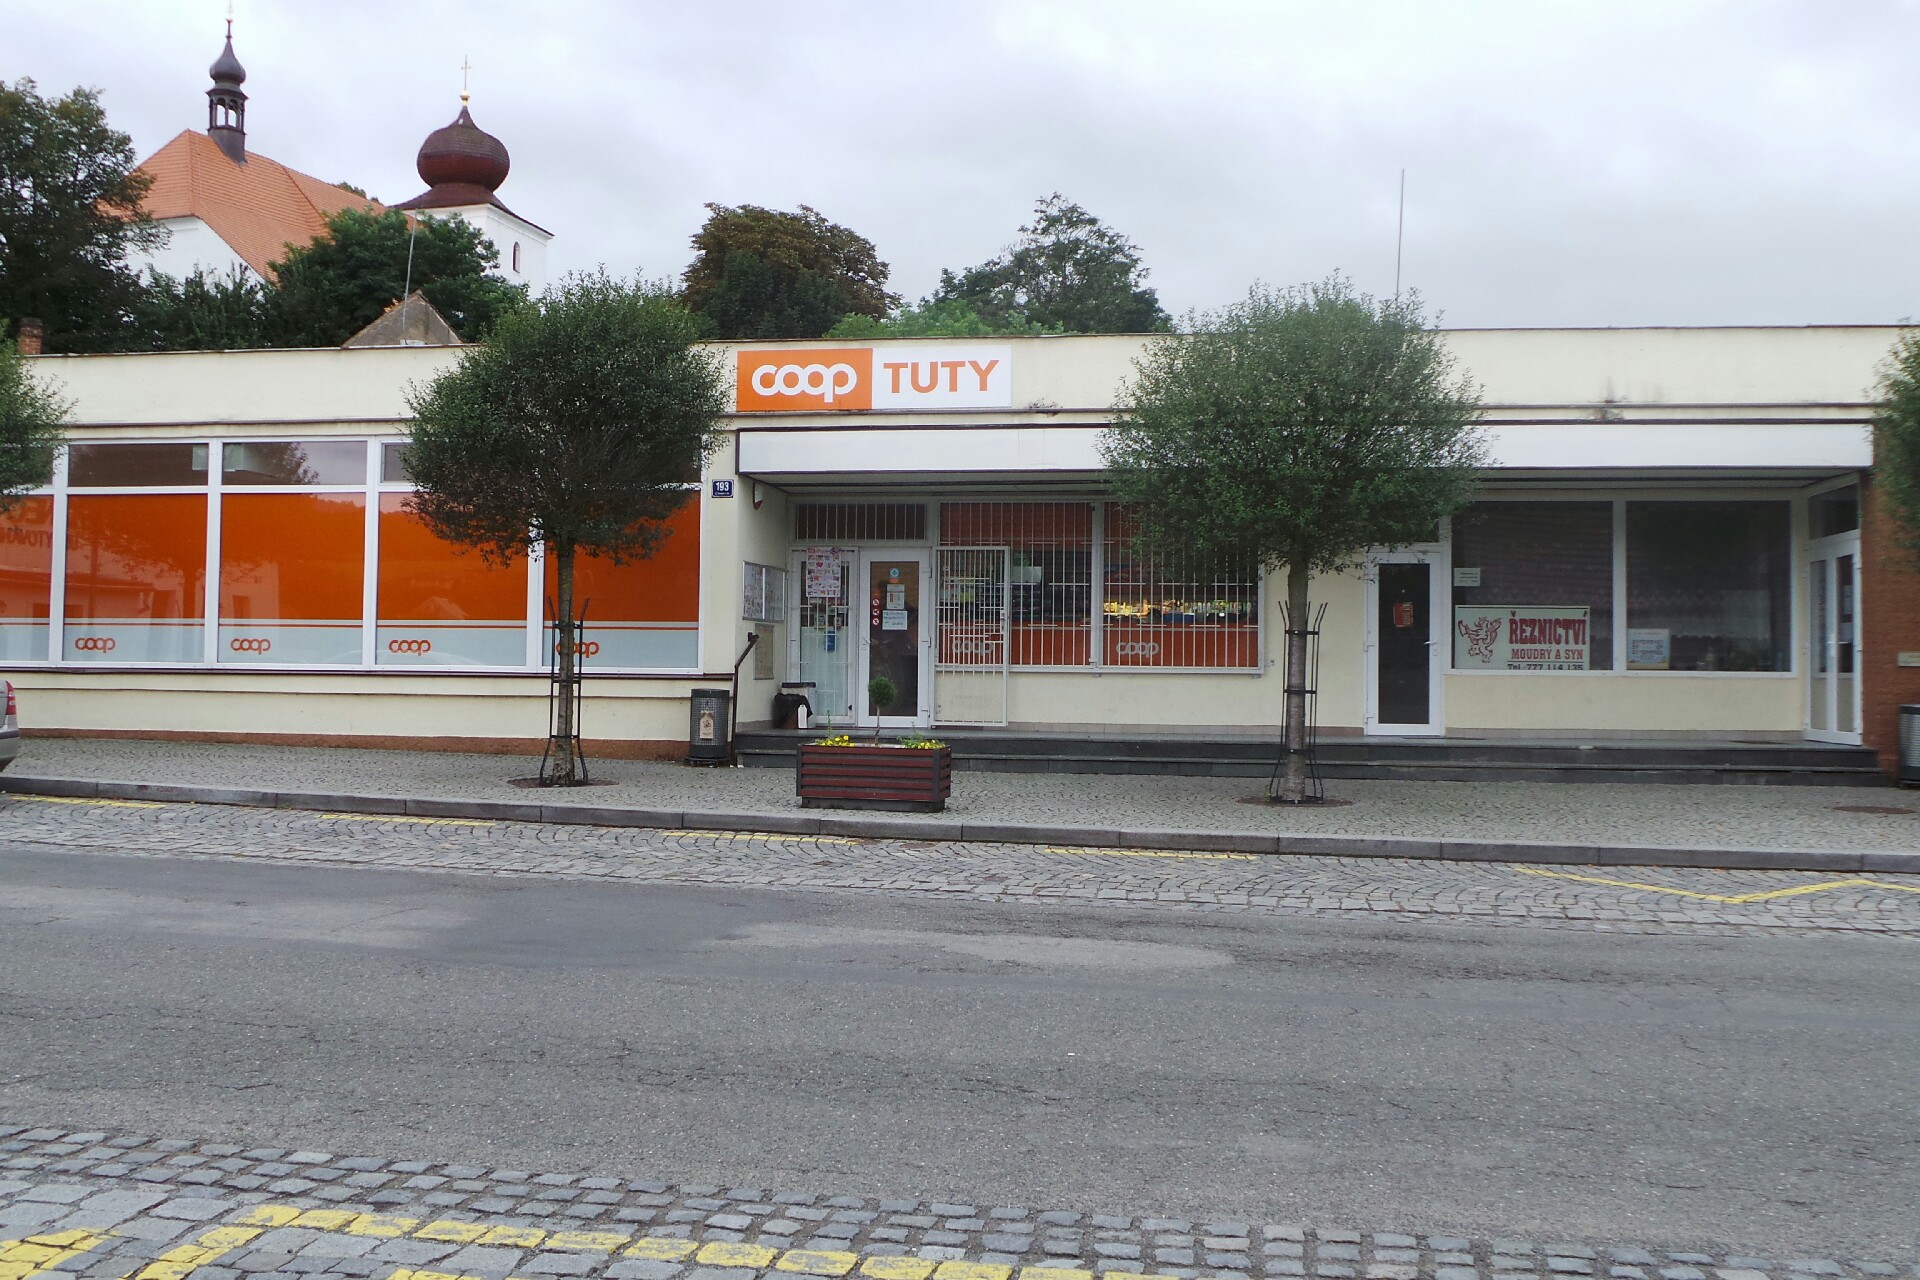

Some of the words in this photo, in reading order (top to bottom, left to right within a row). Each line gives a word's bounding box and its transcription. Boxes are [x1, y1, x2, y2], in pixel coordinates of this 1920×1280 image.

[752, 363, 857, 403] coop
[883, 360, 999, 394] TUTY
[715, 481, 730, 492] 193
[1509, 610, 1588, 645] ŘEZNICTVÍ
[75, 637, 115, 653] coop
[230, 638, 271, 655] coop
[388, 639, 431, 656] coop
[1511, 646, 1552, 660] MOUDRÝ
[1555, 649, 1561, 660] A
[1564, 649, 1583, 660] SYN
